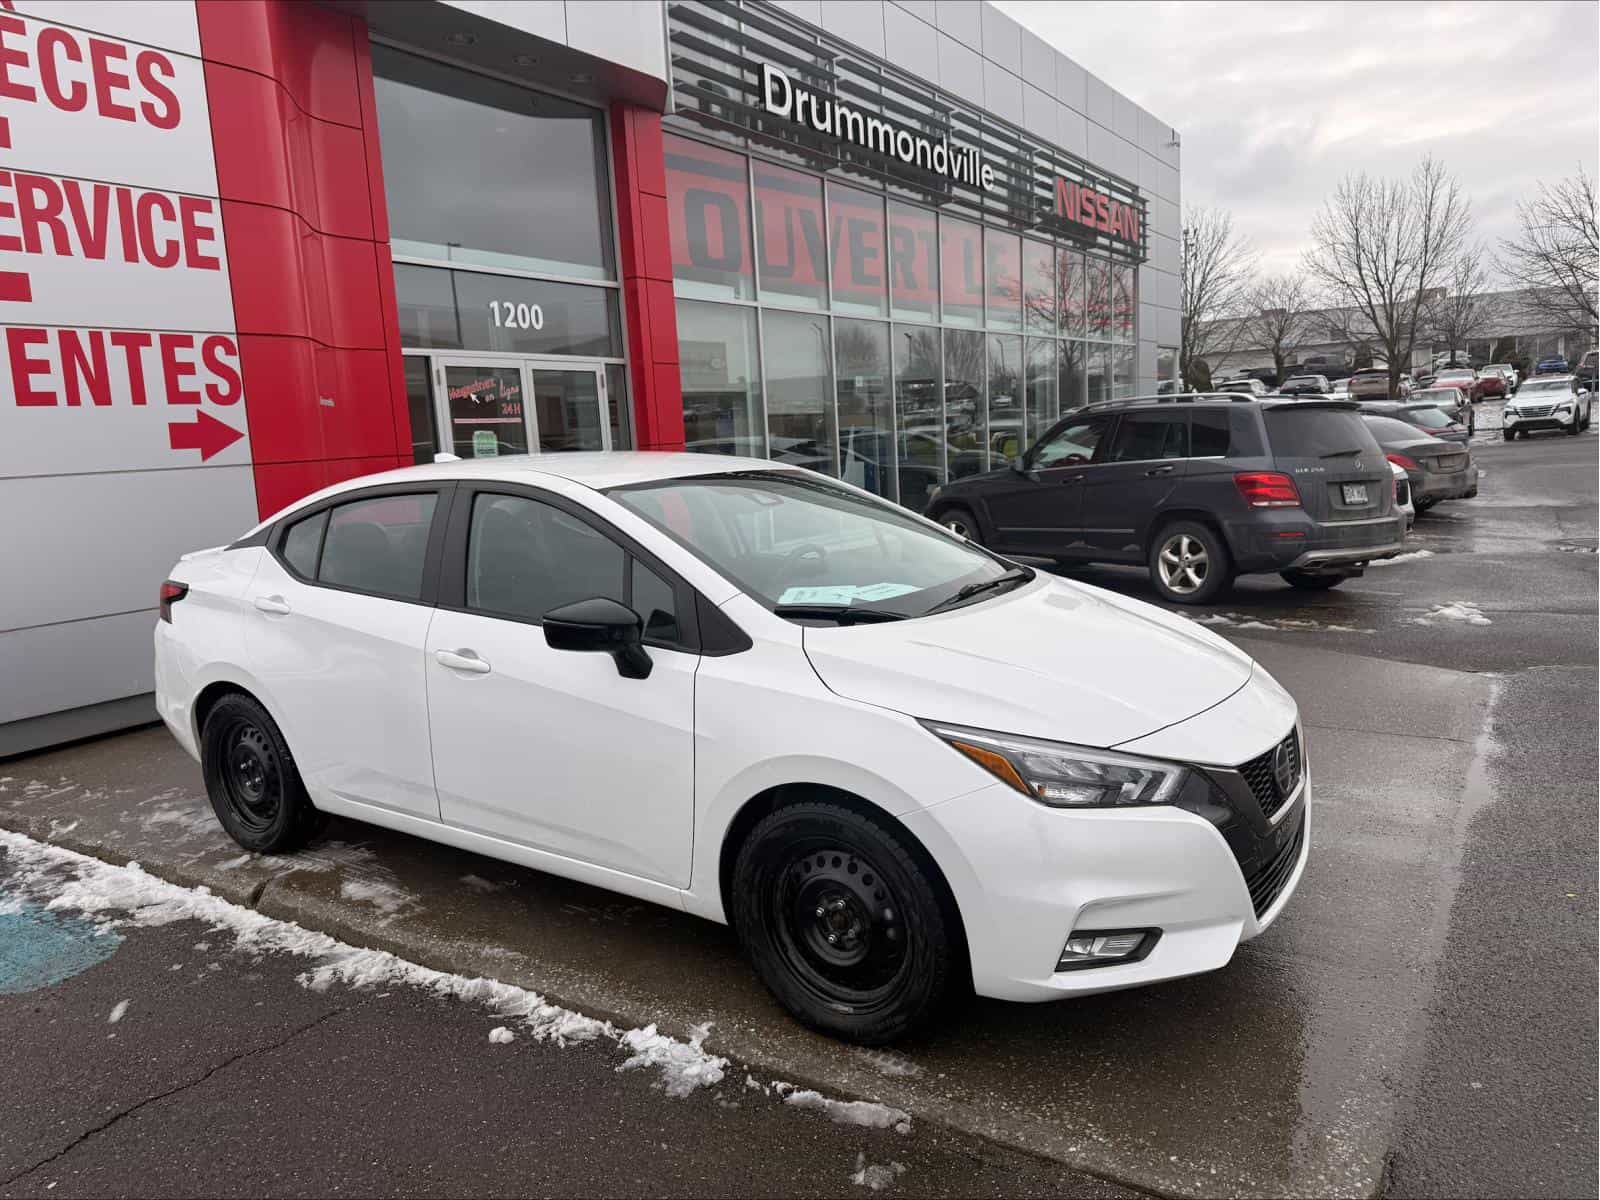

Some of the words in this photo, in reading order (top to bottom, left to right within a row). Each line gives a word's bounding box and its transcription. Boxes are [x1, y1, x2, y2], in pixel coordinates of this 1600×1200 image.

[763, 63, 995, 191] Drummondville
[684, 187, 947, 291] OUVERT
[1056, 176, 1139, 244] NISSAN
[490, 300, 544, 330] 1200
[6, 327, 243, 407] ENTES
